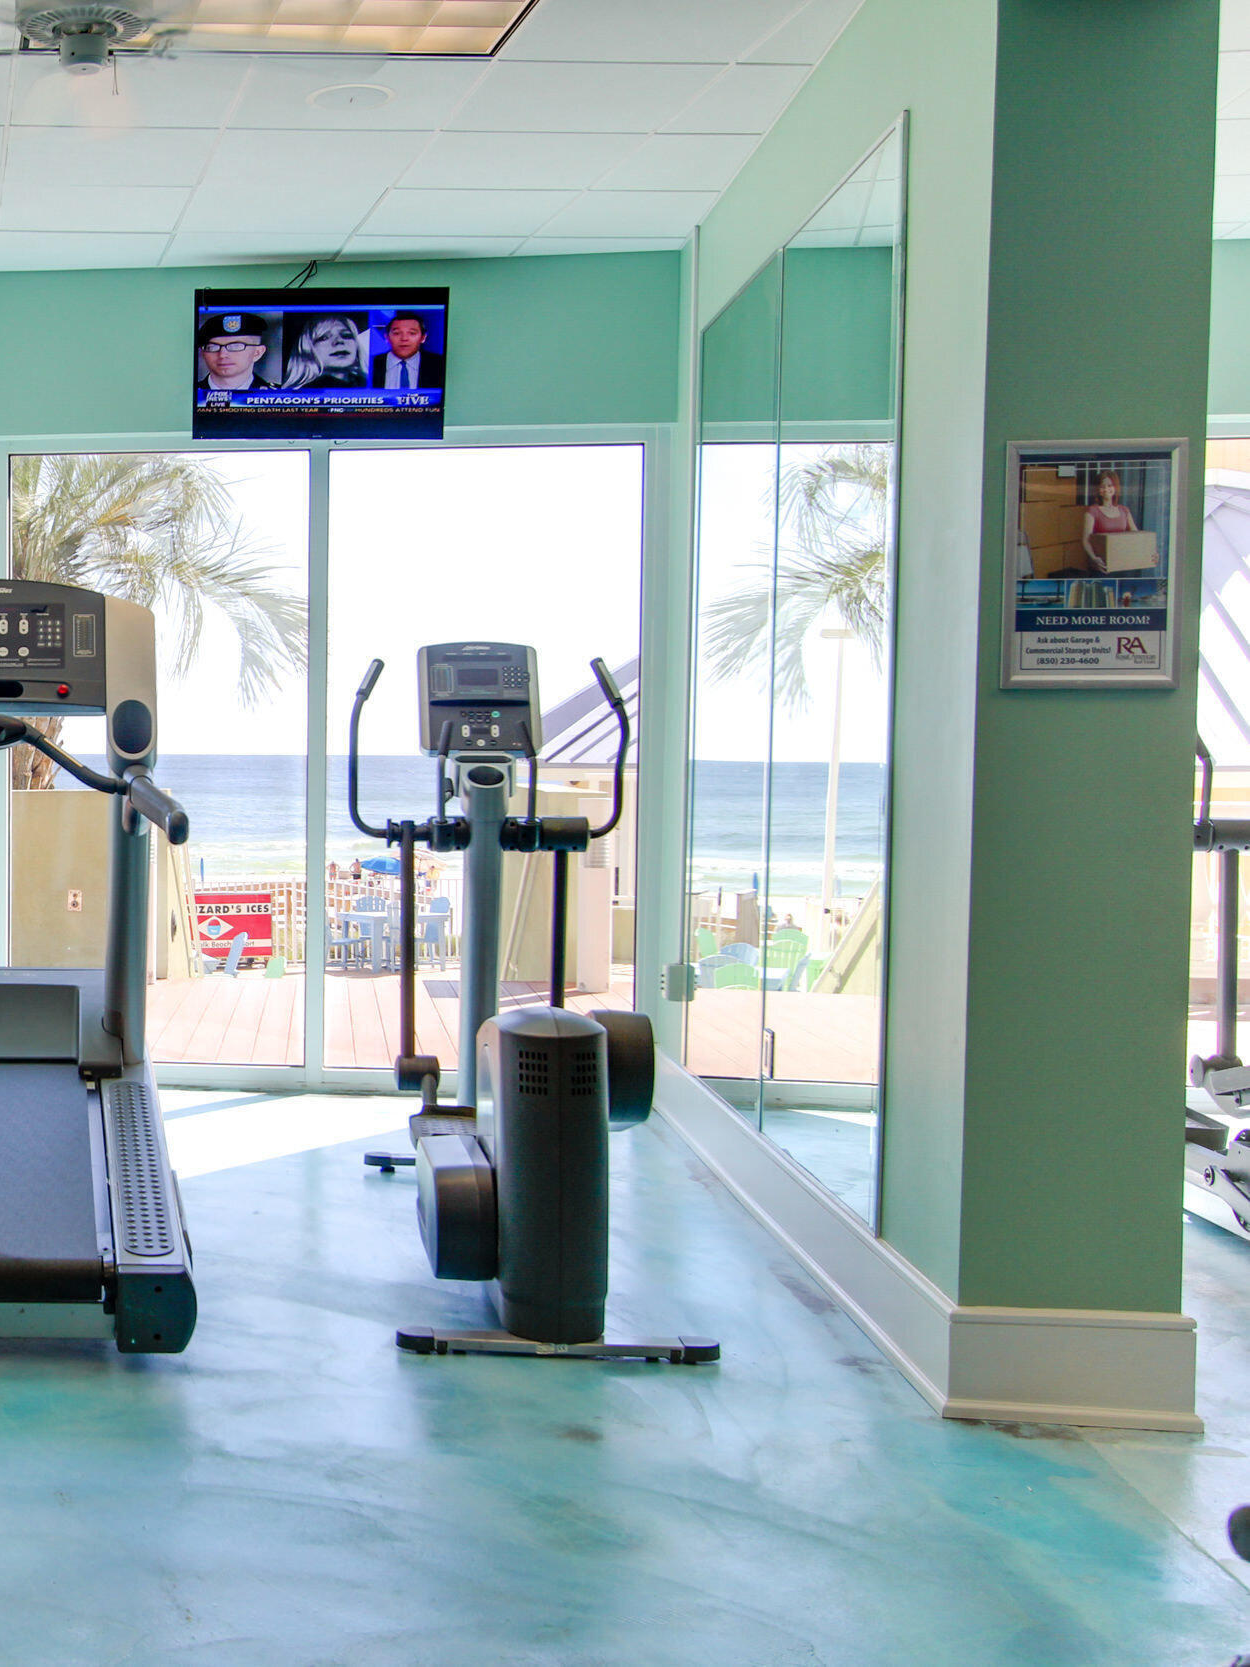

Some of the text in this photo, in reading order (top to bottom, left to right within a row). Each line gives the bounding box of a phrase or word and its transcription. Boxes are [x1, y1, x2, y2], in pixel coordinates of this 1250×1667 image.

[396, 396, 430, 405] FIVE
[1036, 615, 1151, 625] NEED MORE ROOM?
[1070, 637, 1094, 645] Garage
[1116, 637, 1147, 654] RA
[1065, 647, 1090, 655] Storage
[1036, 657, 1100, 665] (850) 230-4600
[246, 904, 269, 913] ICES
